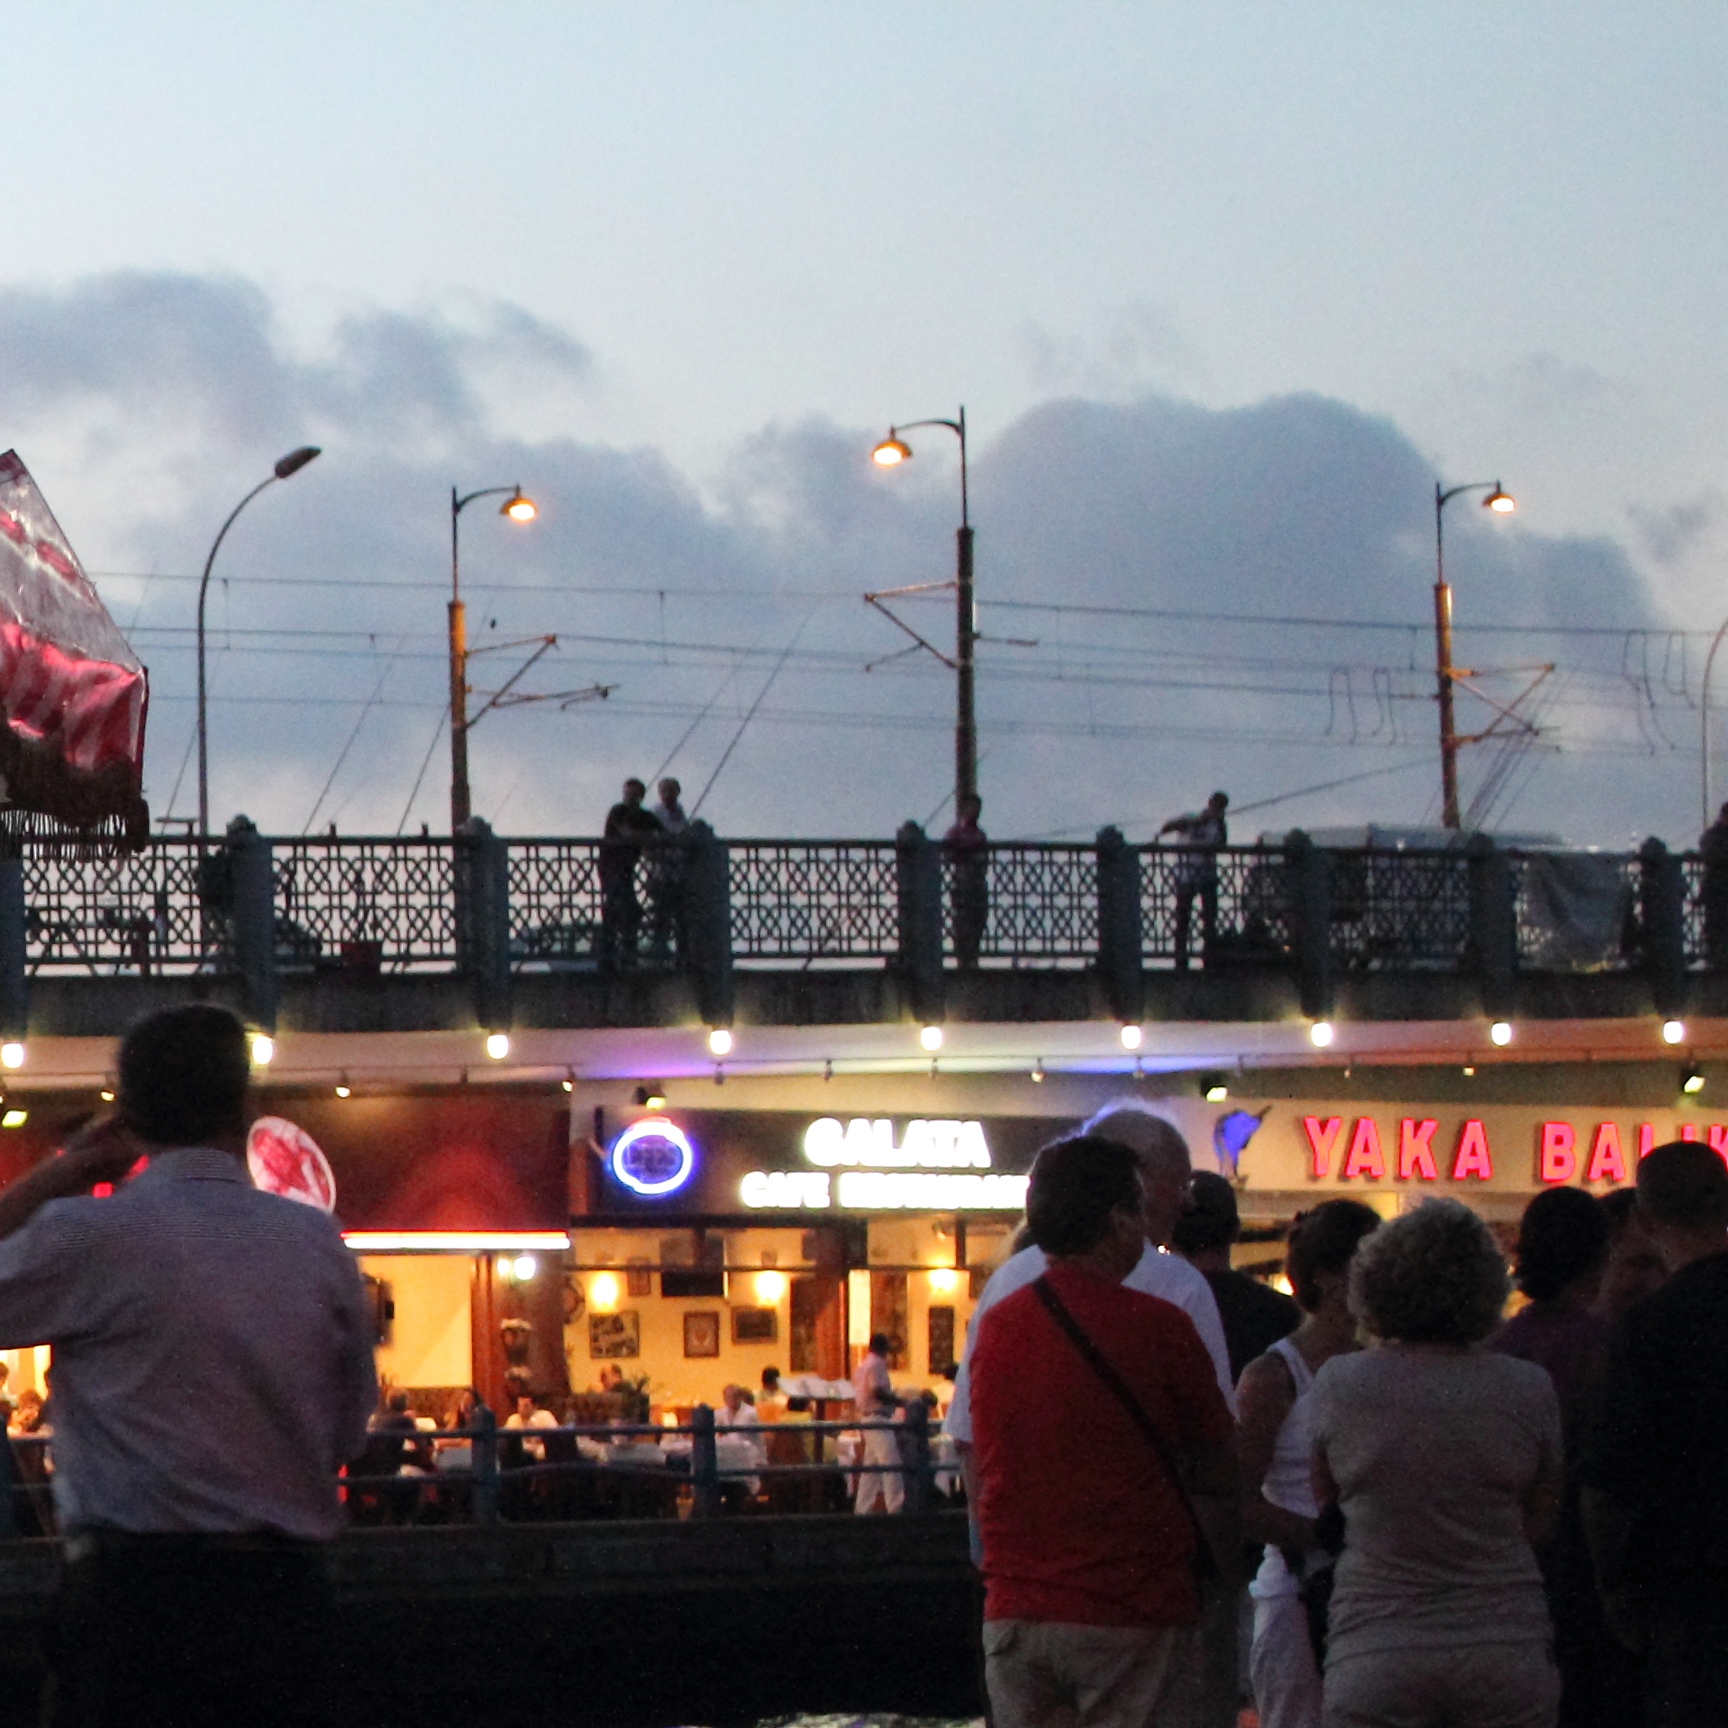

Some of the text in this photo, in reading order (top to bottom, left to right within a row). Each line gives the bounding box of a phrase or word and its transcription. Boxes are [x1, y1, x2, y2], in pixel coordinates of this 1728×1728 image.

[804, 1117, 992, 1168] GALATA
[1304, 1116, 1491, 1180] YAKA
[740, 1171, 832, 1208] CAFE
